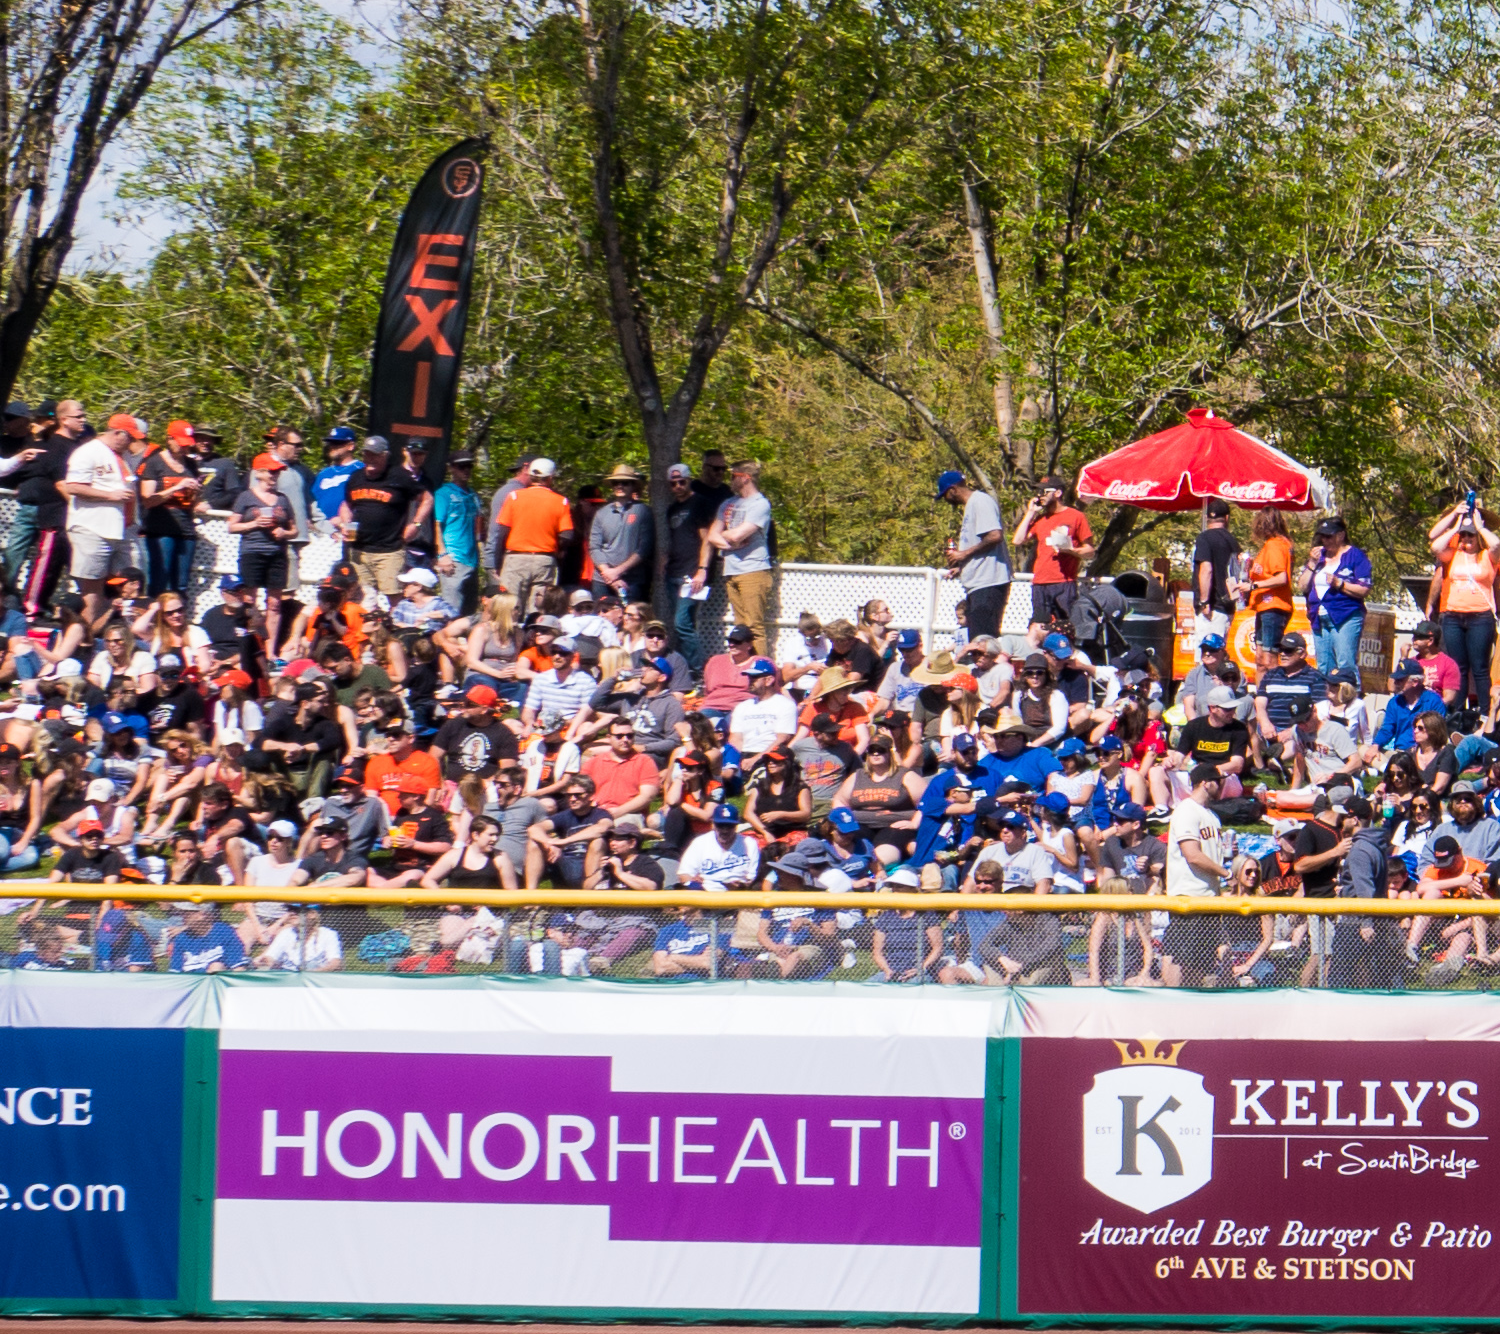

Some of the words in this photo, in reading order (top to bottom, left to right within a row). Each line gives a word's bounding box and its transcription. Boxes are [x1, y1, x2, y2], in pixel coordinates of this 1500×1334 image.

[1218, 480, 1278, 500] Coca-Cola
[1359, 653, 1387, 668] IGHT
[1230, 1079, 1480, 1128] KELLY'S
[1116, 1095, 1184, 1176] K
[1302, 1151, 1331, 1170] at
[1079, 1218, 1203, 1247] Awarded
[1210, 1220, 1270, 1248] Best
[1278, 1220, 1378, 1256] Burger
[1390, 1222, 1412, 1248] &
[1420, 1221, 1492, 1250] Patio
[1155, 1255, 1185, 1279] 6th
[1191, 1257, 1247, 1280] AVE
[1252, 1258, 1278, 1280] &
[1283, 1257, 1416, 1282] STETSON
